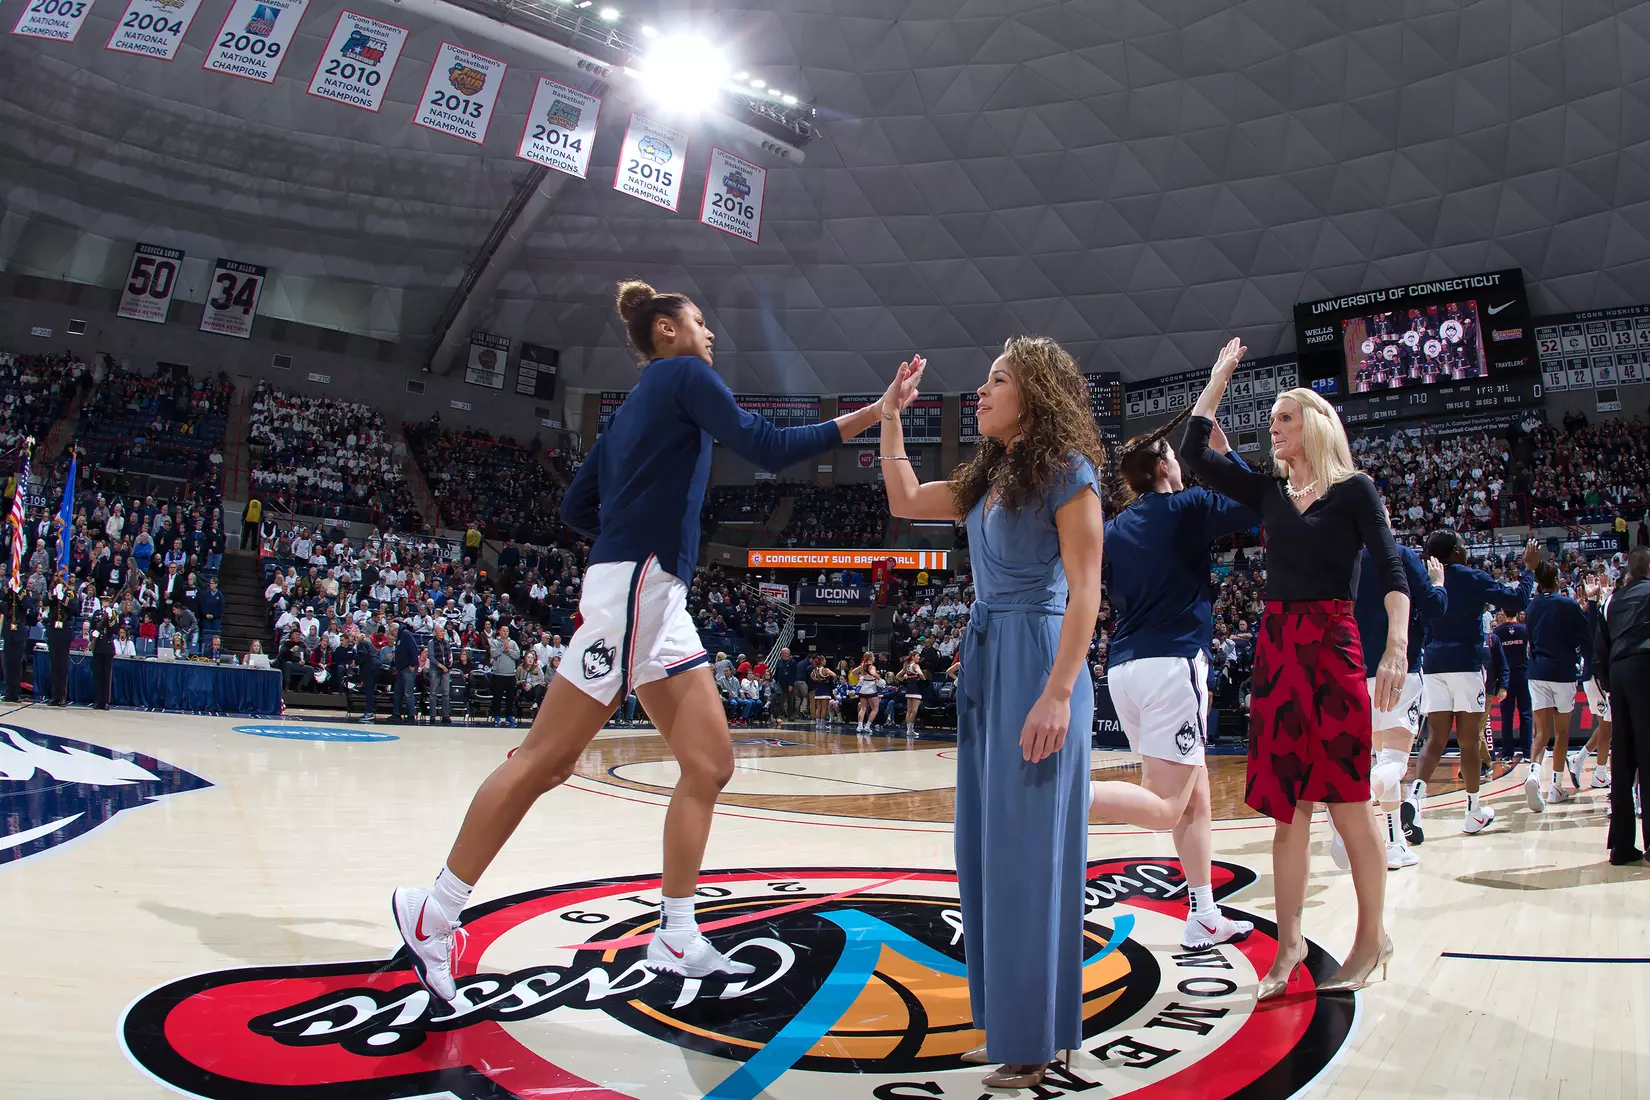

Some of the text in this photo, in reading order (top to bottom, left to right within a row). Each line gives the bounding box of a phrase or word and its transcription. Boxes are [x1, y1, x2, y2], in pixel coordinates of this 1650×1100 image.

[31, 0, 87, 18] 2003
[29, 16, 70, 28] NATIONAL
[123, 12, 184, 36] 2004
[347, 13, 370, 25] UConn
[21, 26, 70, 38] CHAMPIONS
[354, 23, 390, 38] Basketball
[124, 31, 168, 46] NATIONAL
[219, 32, 281, 58] 2009
[115, 40, 168, 56] CHAMPIONS
[447, 44, 470, 56] UConn
[220, 52, 267, 68] NATIONAL
[454, 55, 489, 71] Basketball
[212, 60, 268, 78] CHAMPIONS
[325, 59, 381, 86] 2010
[324, 78, 372, 96] NATIONAL
[316, 86, 372, 107] CHAMPIONS
[430, 90, 484, 118] 2013
[552, 90, 585, 106] Basketball
[430, 108, 476, 128] NATIONAL
[422, 116, 477, 139] CHAMPIONS
[532, 124, 582, 153] 2014
[532, 142, 577, 163] NATIONAL
[526, 150, 578, 173] CHAMPIONS
[628, 158, 672, 186] 2015
[628, 176, 668, 196] NATIONAL
[622, 184, 671, 207] CHAMPIONS
[712, 192, 754, 220] 2016
[712, 208, 750, 228] NATIONAL
[708, 216, 752, 238] CHAMPIONS
[128, 256, 176, 299] 50
[210, 273, 258, 316] 34
[1312, 274, 1501, 314] UNIVERSITY OF CONNECTICUT
[1576, 307, 1641, 320] UCONN HUSKIES
[1305, 326, 1334, 336] WELLS
[1616, 332, 1631, 344] 13
[1306, 334, 1334, 344] FARGO
[1540, 340, 1558, 352] 52
[1590, 334, 1608, 347] 00
[1495, 360, 1524, 368] TRAVELERS
[1160, 361, 1256, 384] UCONN HUSKIE ONOR
[1550, 372, 1560, 385] 15
[1574, 370, 1585, 382] 22
[1234, 383, 1250, 395] 44
[1280, 376, 1297, 388] 42
[1312, 378, 1334, 388] CBS
[1153, 399, 1159, 410] 9
[1170, 394, 1184, 406] 22
[1131, 403, 1140, 413] C
[1238, 414, 1250, 425] 13
[30, 496, 46, 506] 109
[1601, 539, 1618, 548] 116
[436, 548, 450, 557] 110
[766, 555, 830, 563] CONNECTICUT
[854, 556, 915, 564] BASKEALL
[816, 588, 860, 600] UCONN
[925, 588, 934, 596] 113
